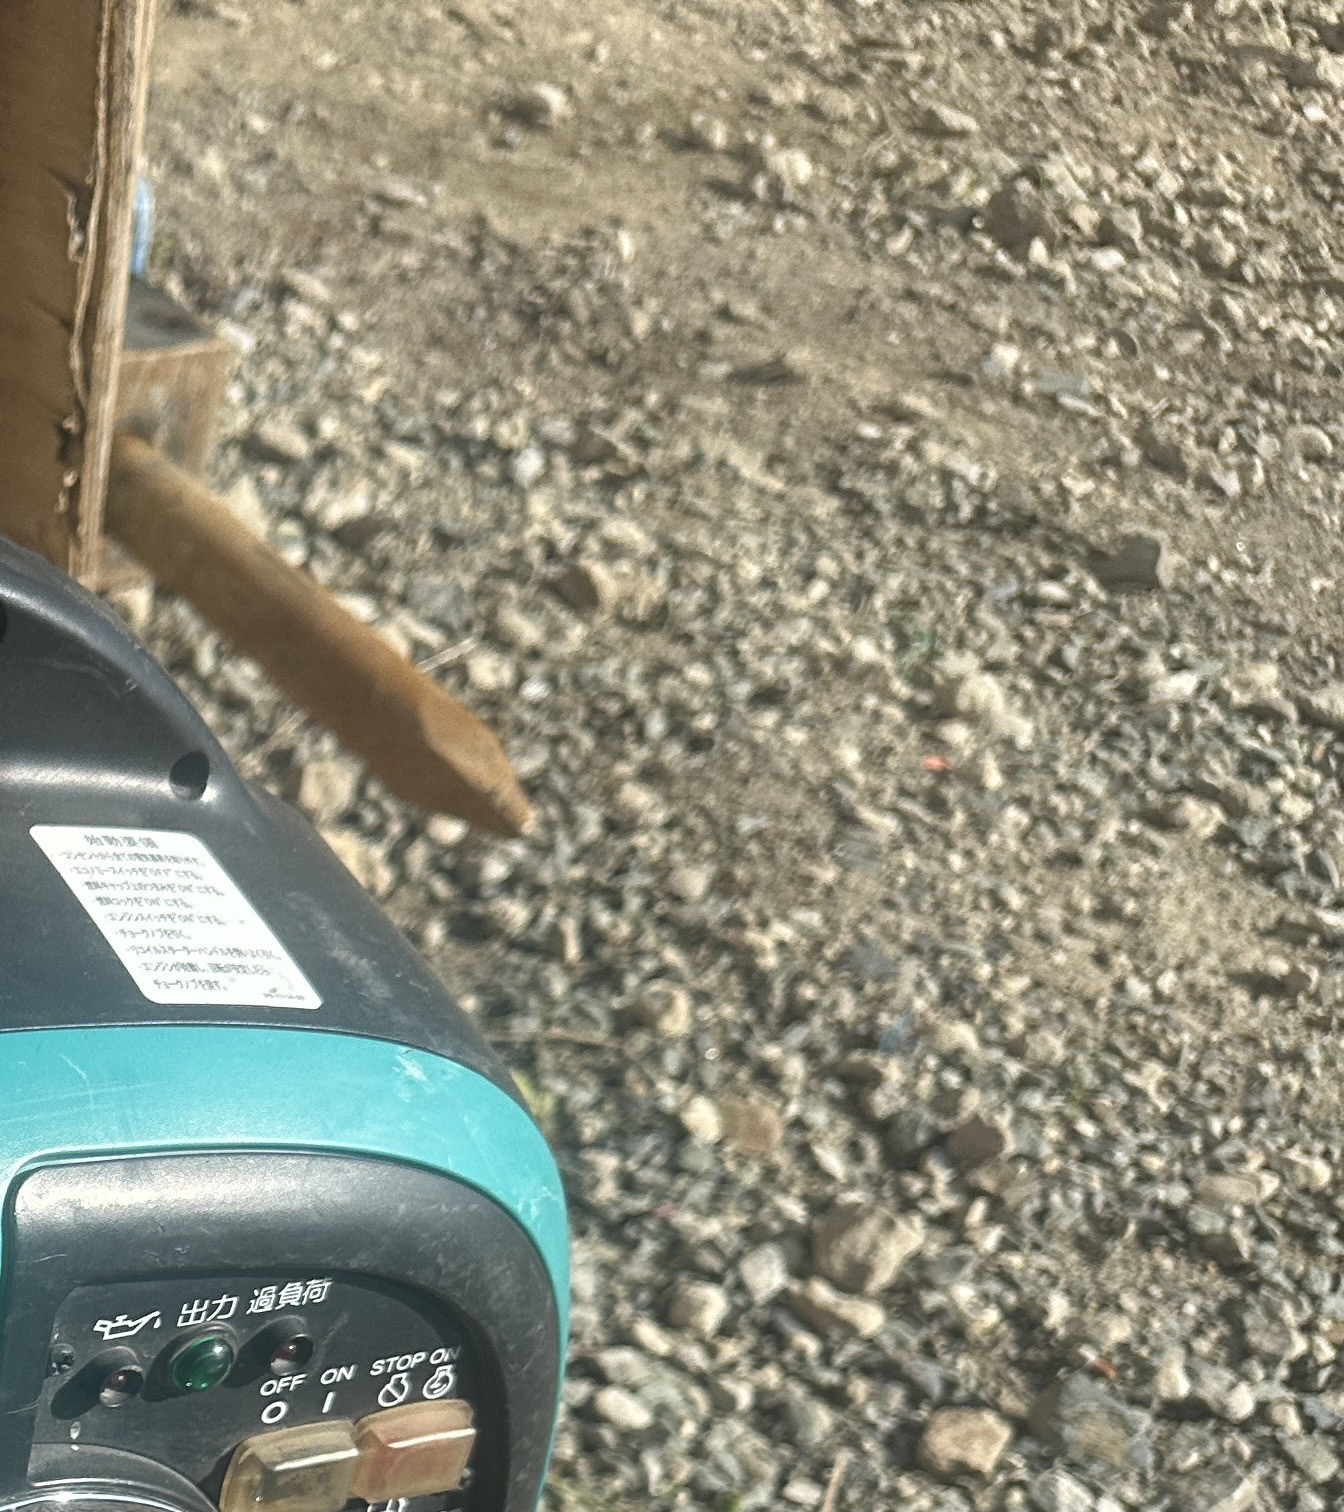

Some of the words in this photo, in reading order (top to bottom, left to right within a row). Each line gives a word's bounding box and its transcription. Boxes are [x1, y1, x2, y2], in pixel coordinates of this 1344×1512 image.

[177, 1293, 239, 1327] 出力
[246, 1277, 332, 1316] 過負荷
[369, 1351, 426, 1377] STOP
[429, 1345, 461, 1365] ON
[260, 1374, 306, 1398] OFF
[320, 1363, 358, 1387] ON
